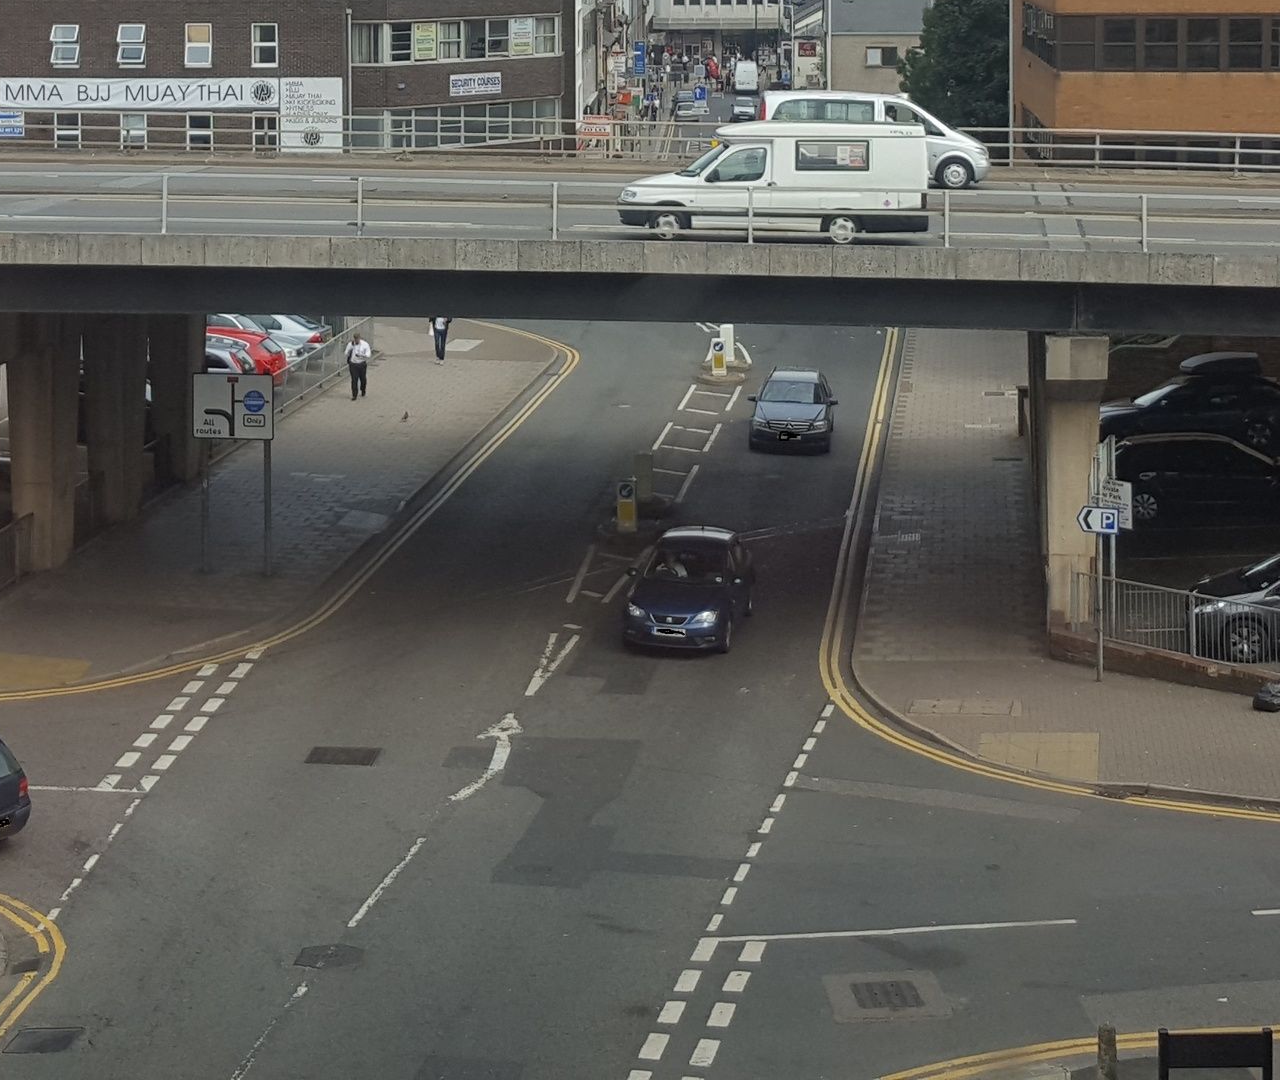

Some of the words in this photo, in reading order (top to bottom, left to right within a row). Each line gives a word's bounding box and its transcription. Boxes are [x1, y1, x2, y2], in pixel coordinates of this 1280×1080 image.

[451, 78, 476, 88] SECURITY
[477, 76, 500, 86] COURSES
[5, 84, 63, 101] MMA
[77, 84, 111, 102] BJJ
[125, 84, 191, 101] MUAY
[197, 84, 243, 101] THAI
[203, 418, 215, 426] All
[1109, 492, 1122, 501] Park
[1103, 513, 1114, 528] P
